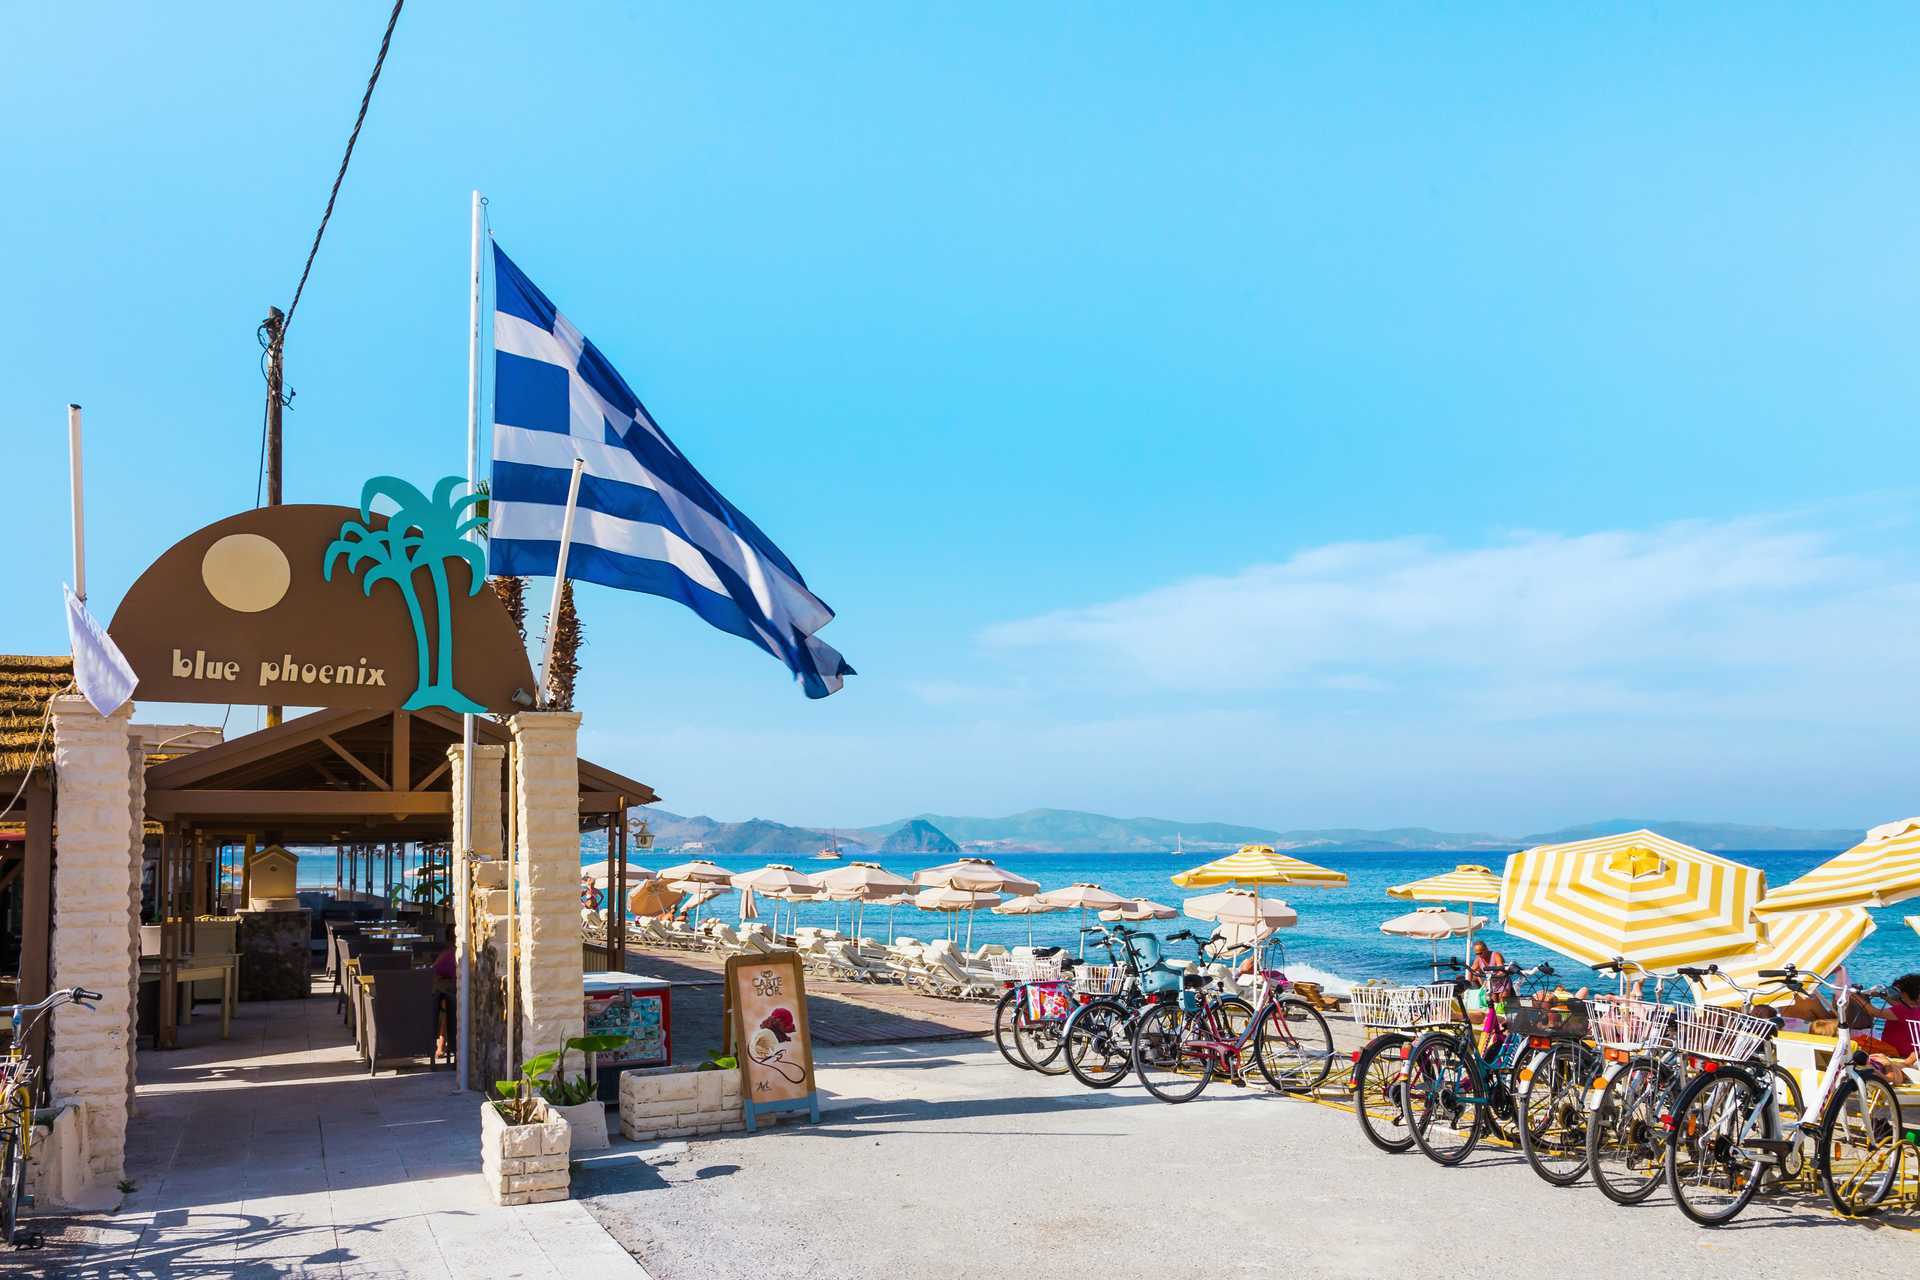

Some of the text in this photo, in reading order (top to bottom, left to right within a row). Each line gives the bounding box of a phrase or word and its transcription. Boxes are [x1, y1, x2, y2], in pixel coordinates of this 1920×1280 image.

[172, 649, 386, 686] blue phoenix
[752, 976, 783, 988] CARTE
